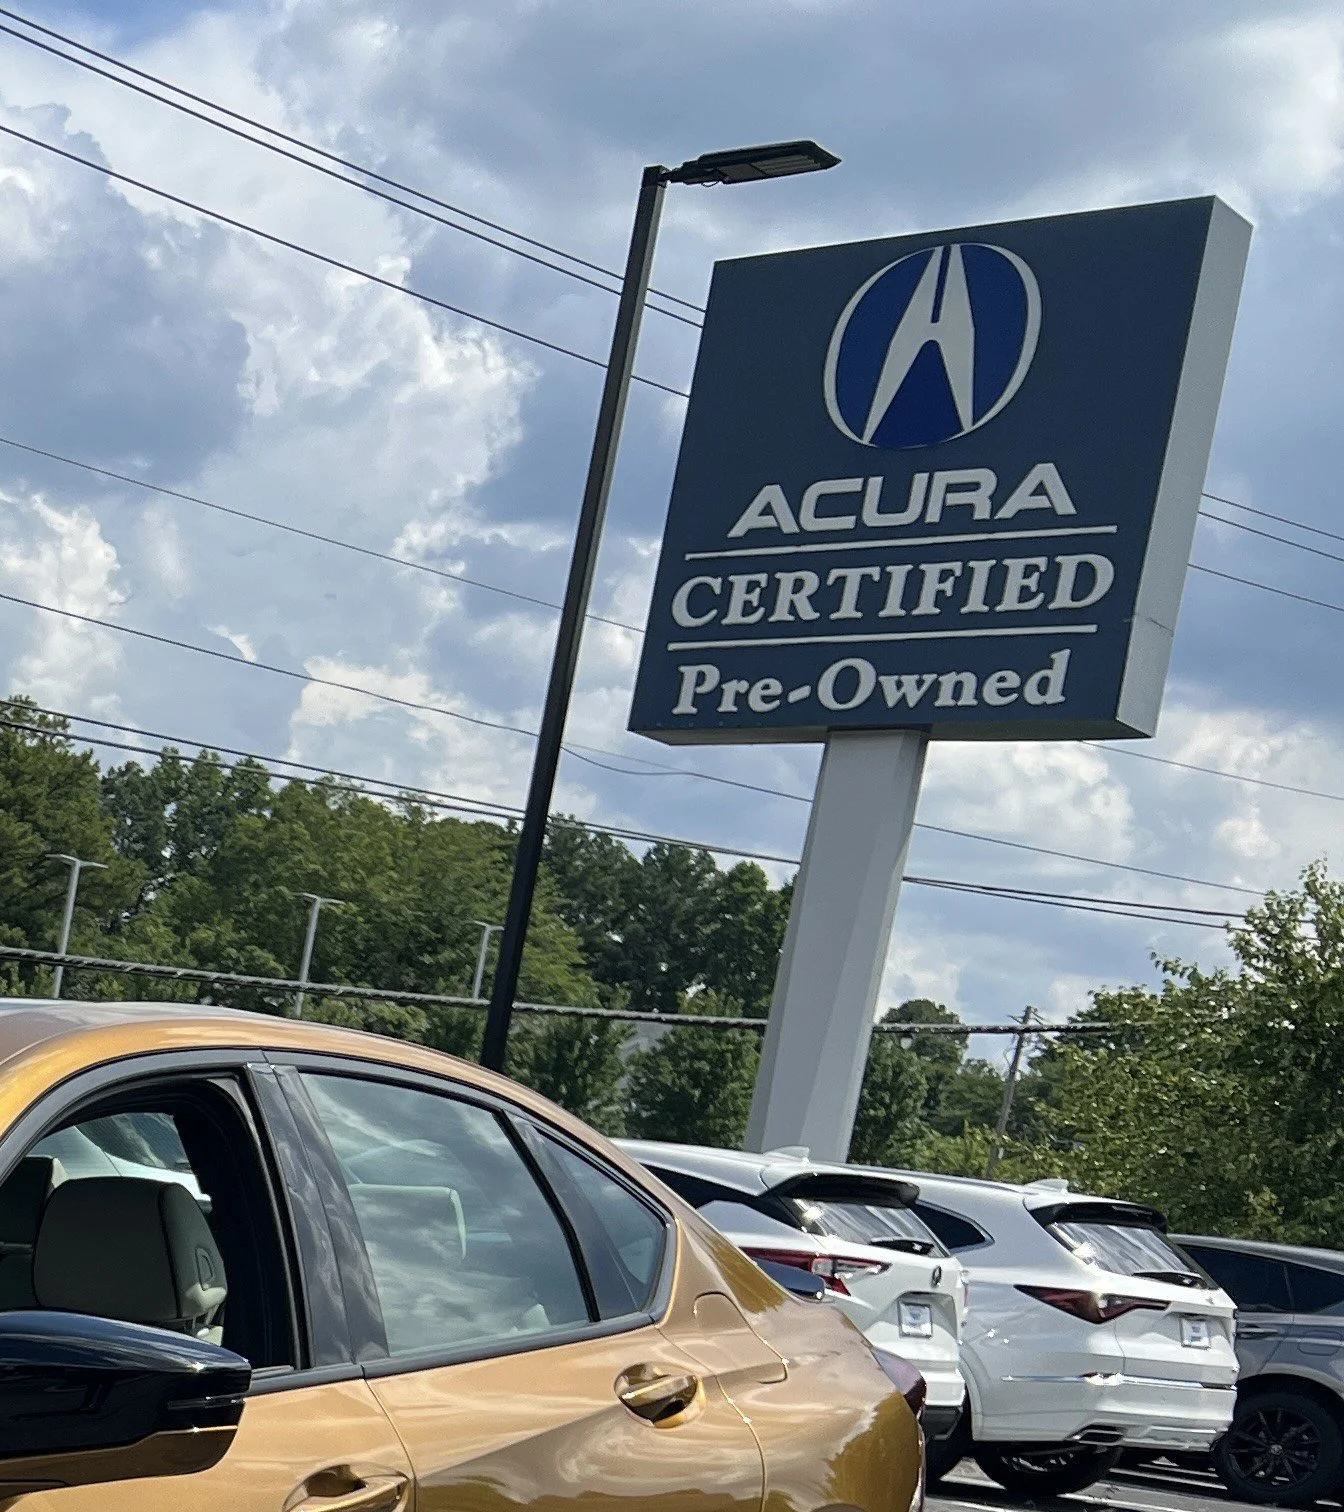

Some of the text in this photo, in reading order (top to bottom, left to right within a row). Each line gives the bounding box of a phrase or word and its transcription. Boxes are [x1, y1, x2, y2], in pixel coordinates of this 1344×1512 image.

[726, 462, 1077, 538] ACURA
[671, 553, 1114, 629] CERTIFIED
[672, 649, 1072, 715] Pre-Owned
